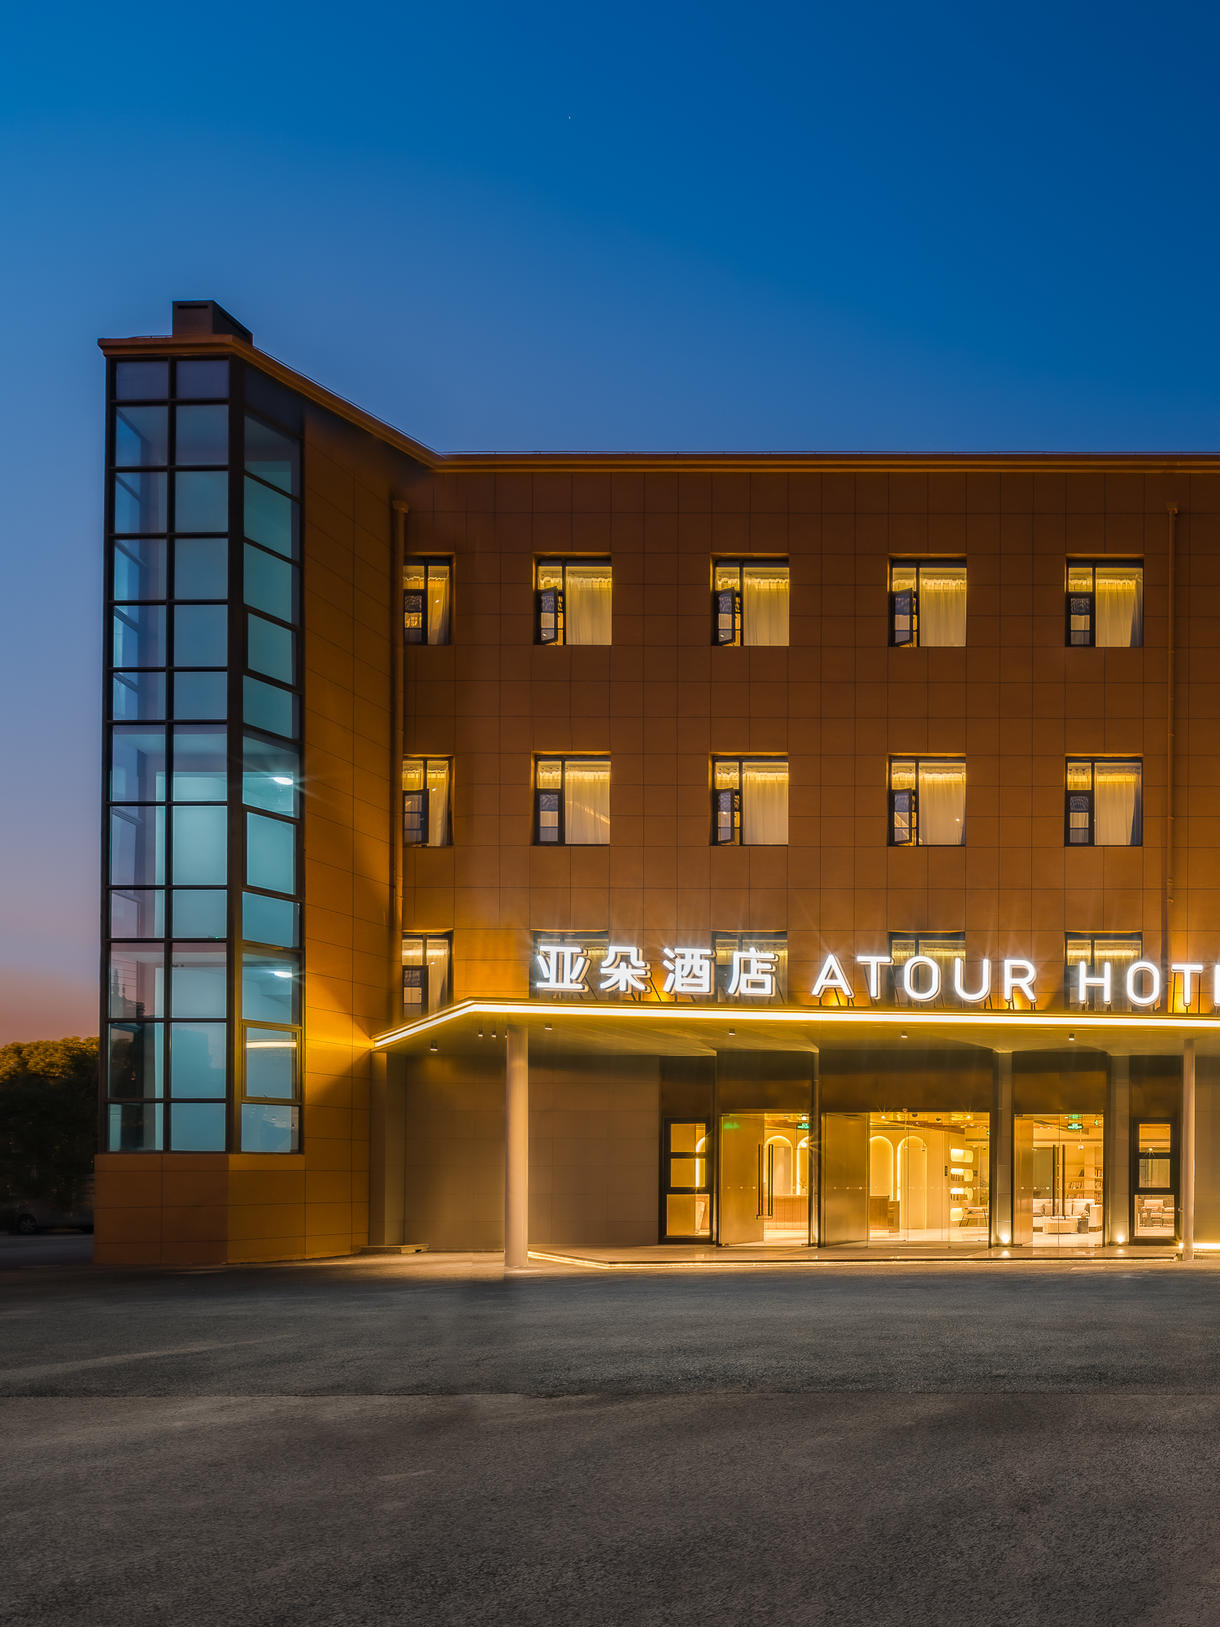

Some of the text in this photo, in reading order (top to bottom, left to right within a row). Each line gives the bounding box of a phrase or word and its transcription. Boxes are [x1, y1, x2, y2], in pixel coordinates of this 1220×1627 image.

[536, 945, 777, 997] 亚朵酒店
[811, 952, 1038, 1003] ATOUR
